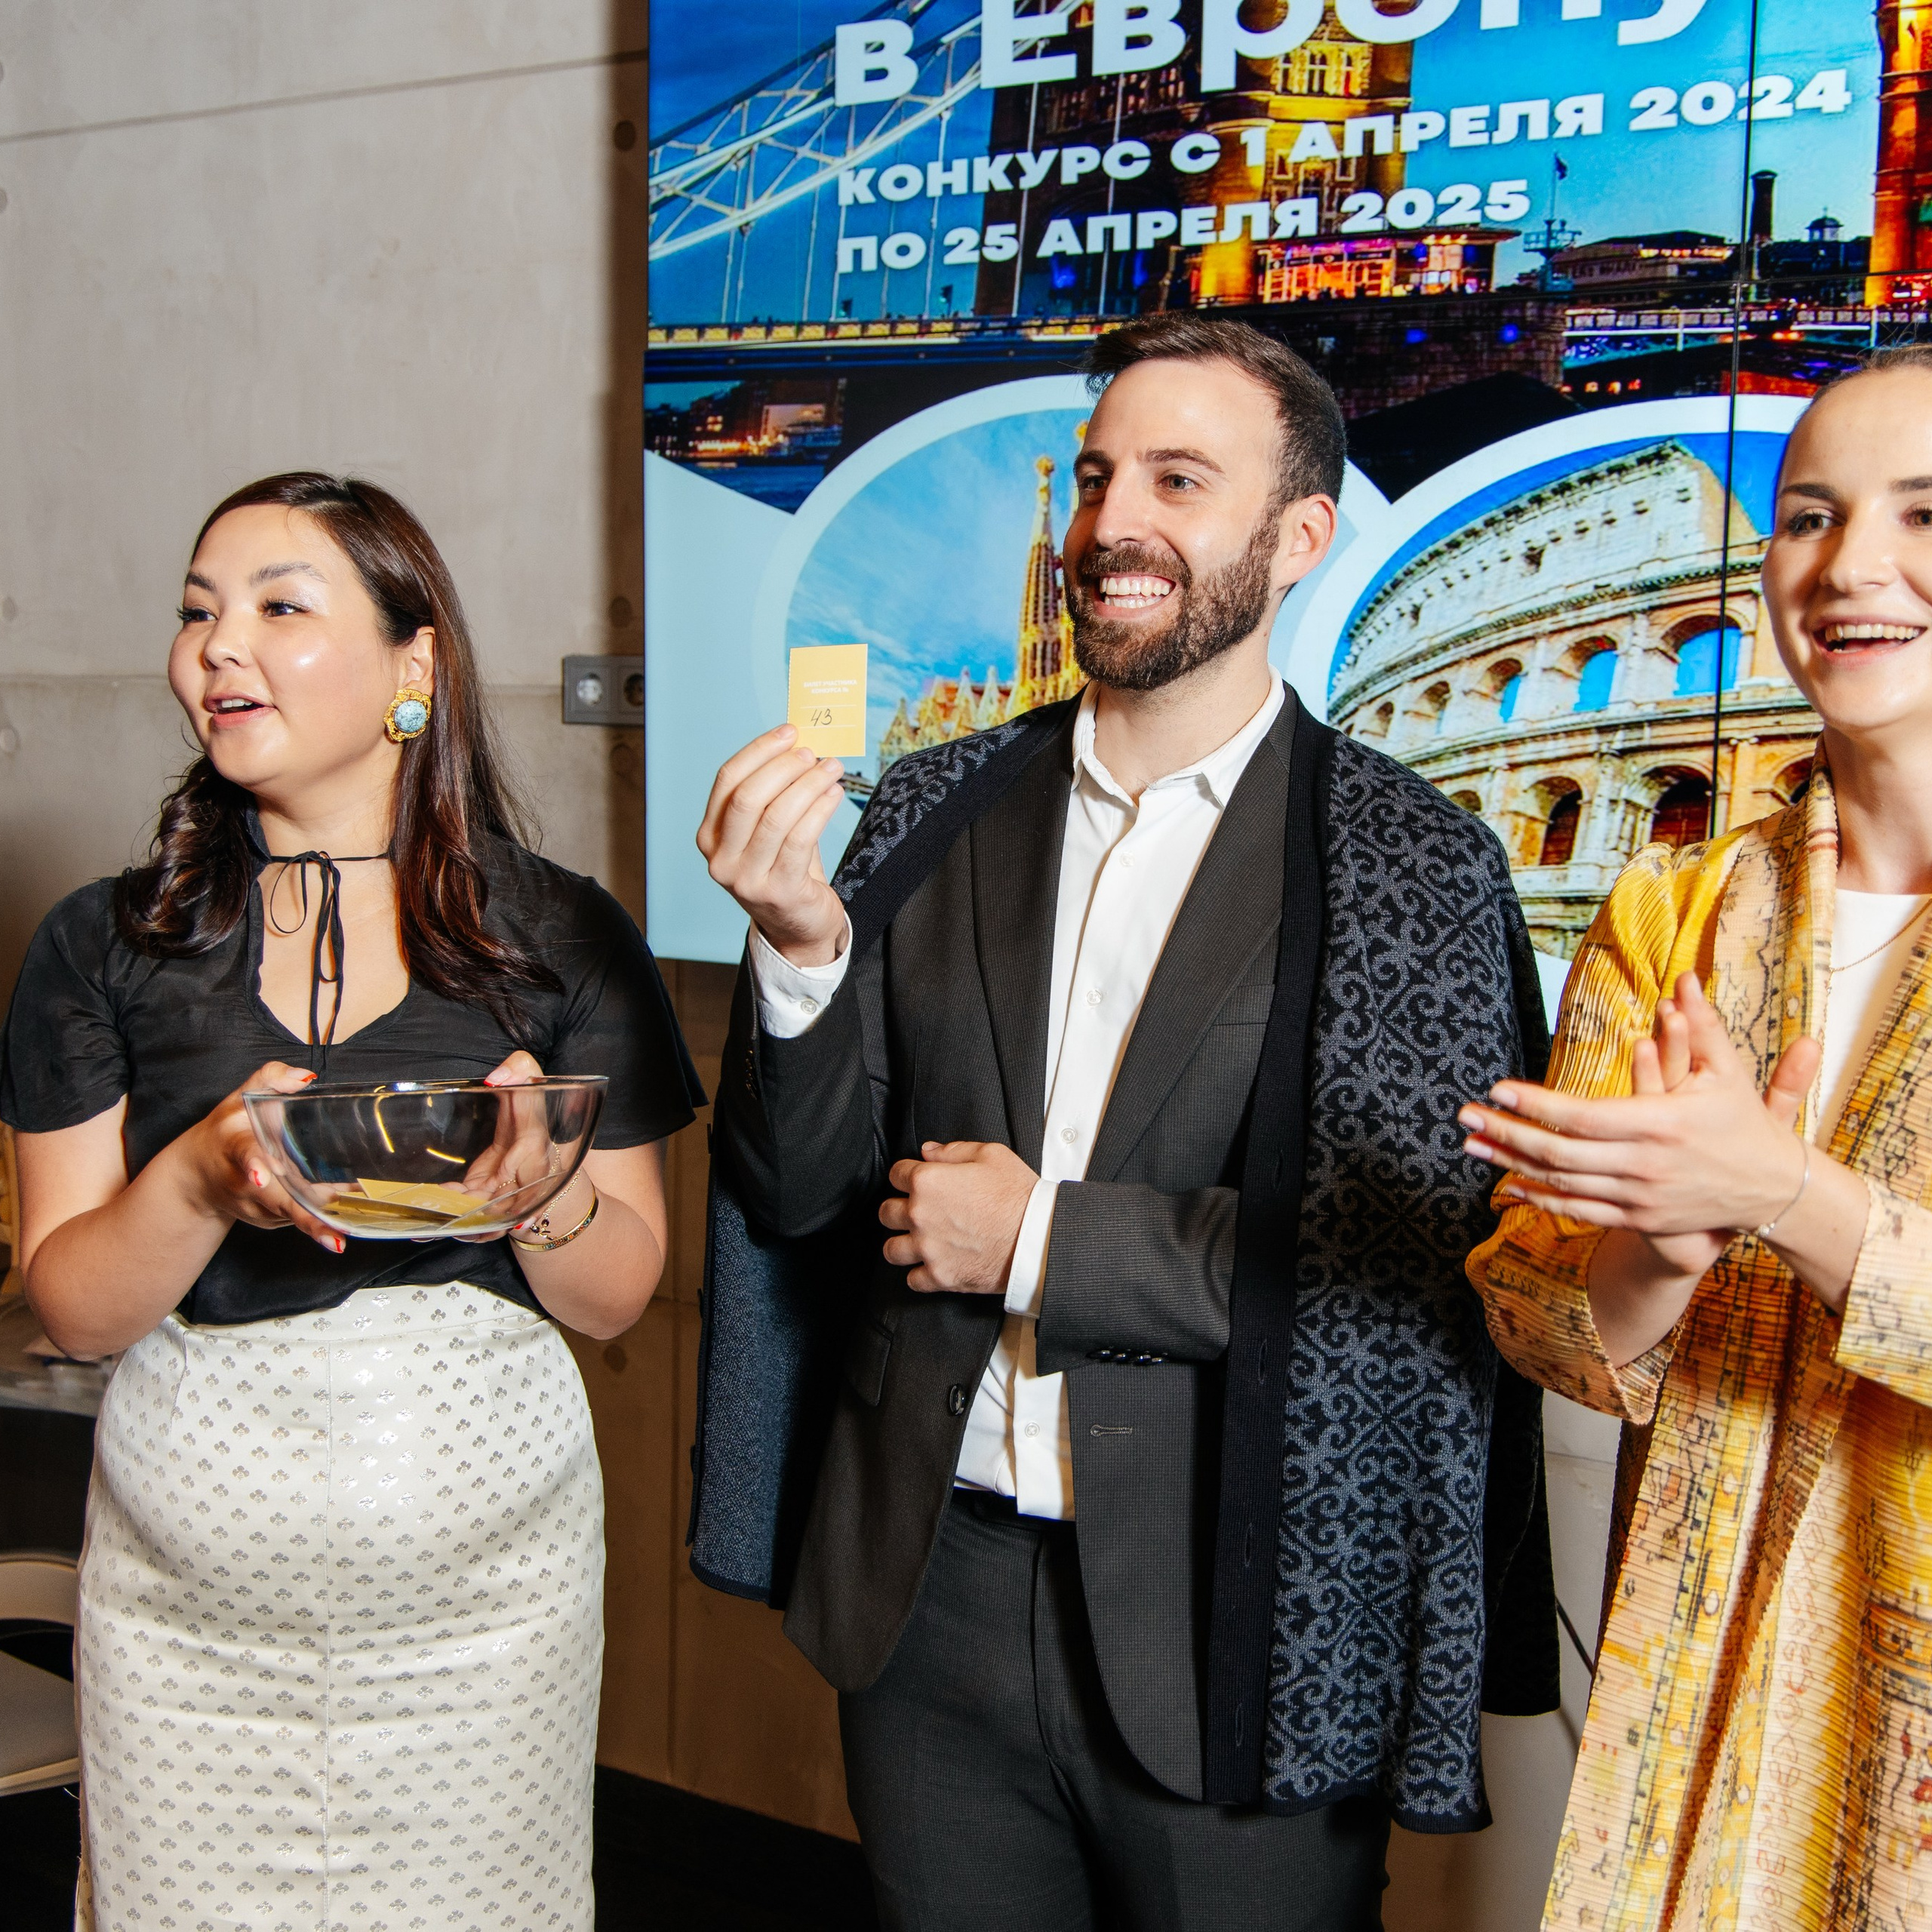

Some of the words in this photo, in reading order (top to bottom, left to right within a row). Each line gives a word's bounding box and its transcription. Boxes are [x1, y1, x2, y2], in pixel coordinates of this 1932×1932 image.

[838, 140, 1152, 206] КОНКУРС
[1170, 134, 1221, 174] С
[1240, 127, 1265, 167] 1
[1288, 93, 1604, 163] АПРЕЛЯ
[1629, 69, 1852, 131] 2024
[838, 232, 928, 274] ПО
[943, 224, 1019, 265] 25
[1035, 197, 1318, 257] АПРЕЛЯ
[1340, 180, 1531, 232] 2025
[811, 708, 832, 727] 43
